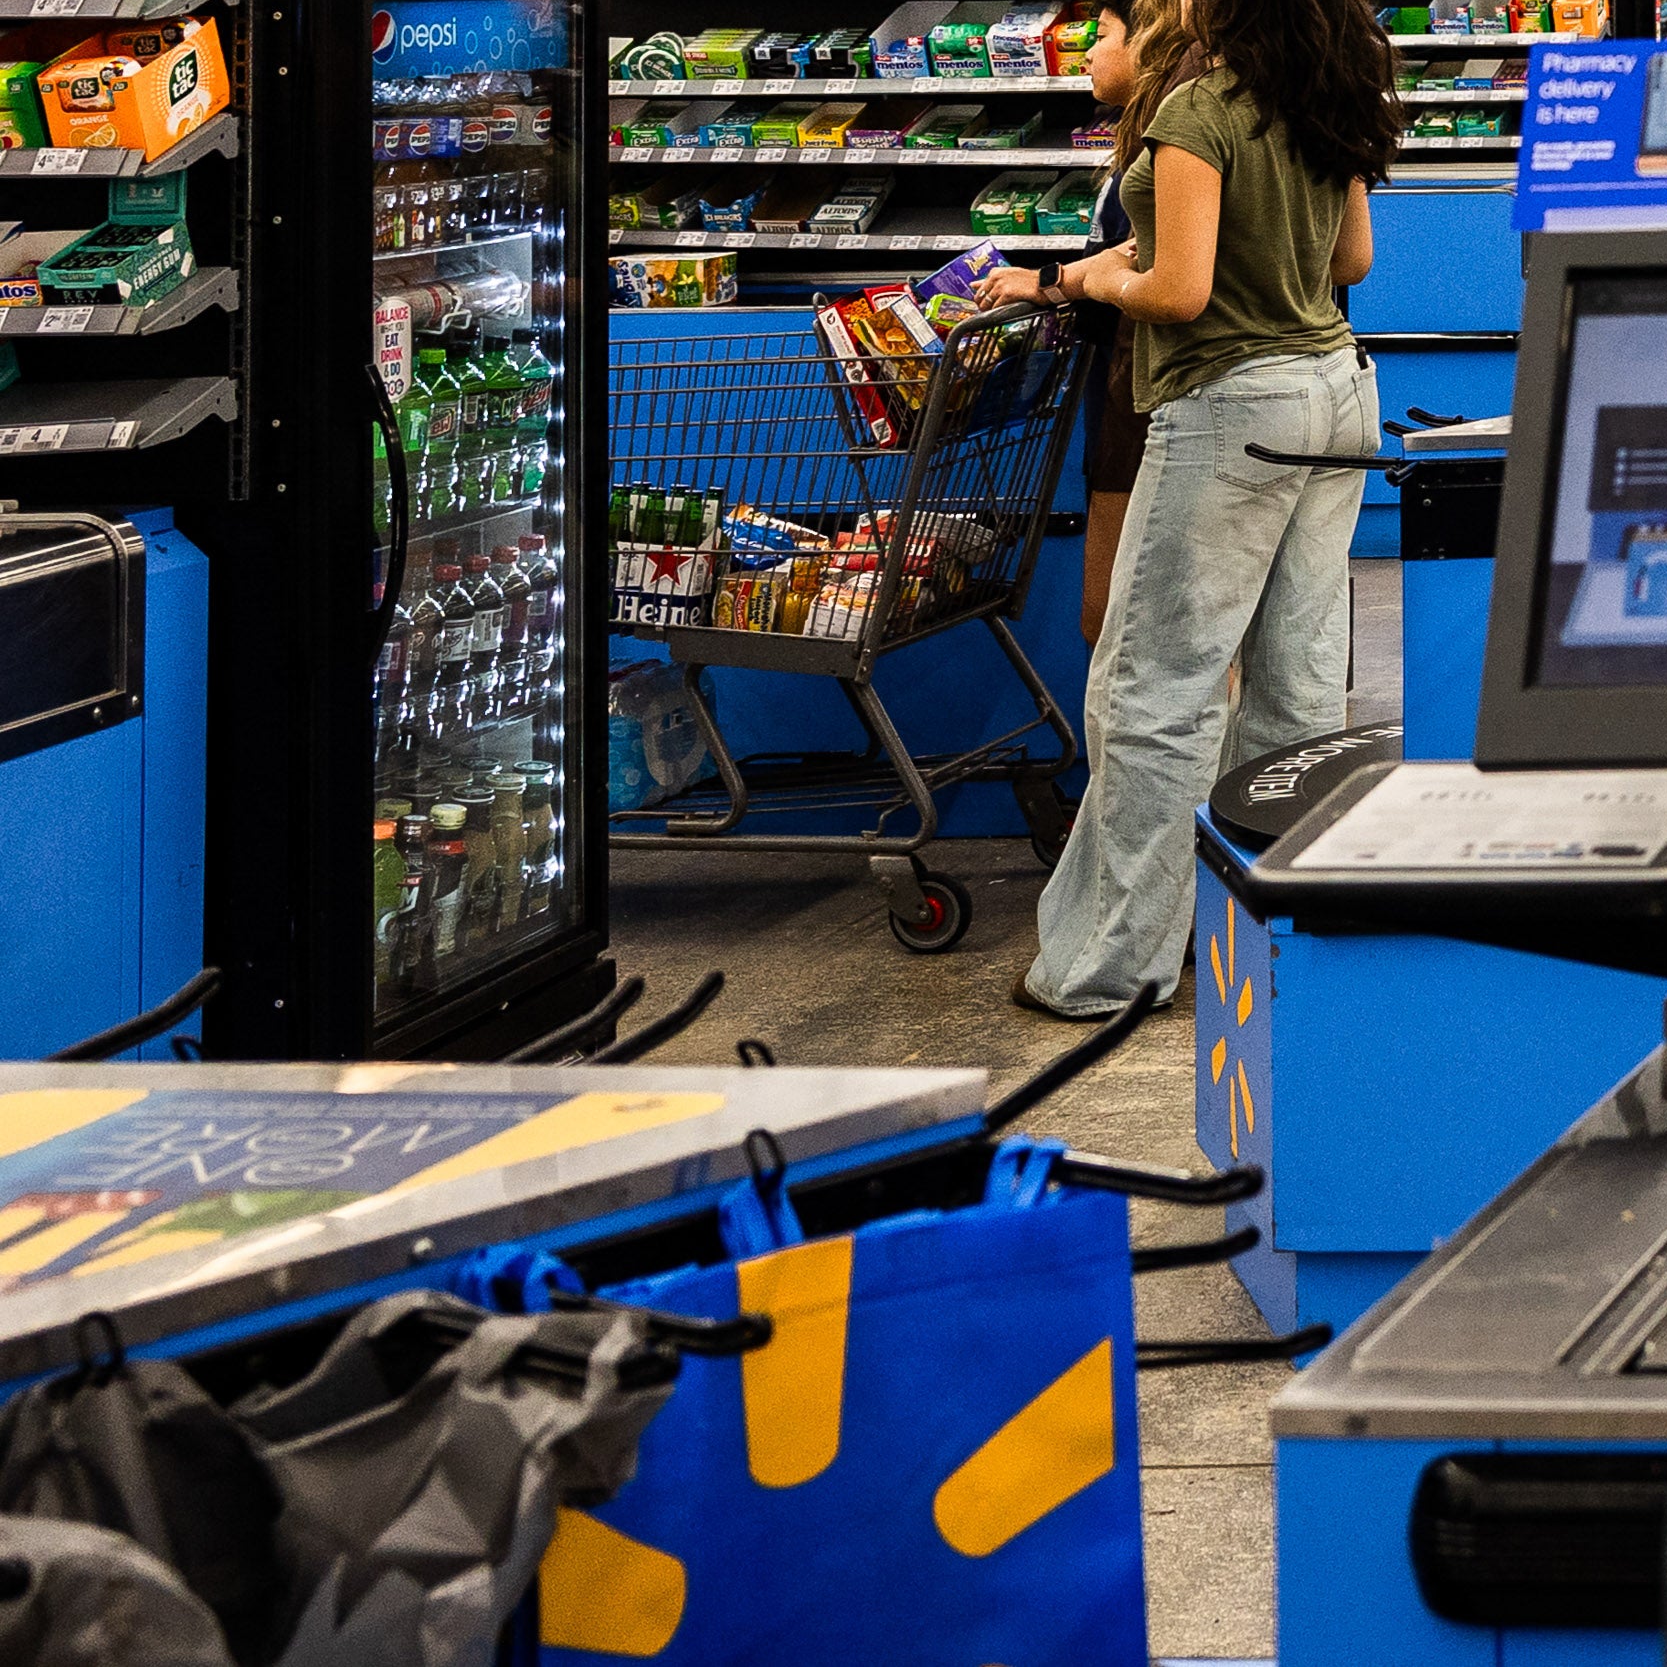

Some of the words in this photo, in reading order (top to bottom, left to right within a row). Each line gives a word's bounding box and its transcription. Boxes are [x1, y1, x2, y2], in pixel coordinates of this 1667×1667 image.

[401, 18, 457, 54] pepsi
[174, 56, 194, 80] tic
[876, 59, 923, 70] mentos
[936, 58, 983, 70] mentos
[993, 58, 1041, 69] mentos
[1542, 52, 1637, 75] Pharmacy
[77, 79, 93, 89] tic
[172, 74, 196, 99] tac
[1539, 79, 1616, 101] delivery
[74, 86, 94, 97] tac
[69, 114, 109, 125] ORANGE
[1536, 104, 1553, 124] is
[1555, 104, 1600, 124] here
[633, 135, 658, 146] Extra
[675, 136, 699, 146] Extra
[719, 136, 743, 146] Extra
[1075, 138, 1115, 147] mento
[820, 206, 861, 215] ALTOIDS
[761, 225, 797, 233] ALTOIDS
[133, 258, 167, 290] ENERGY
[163, 247, 181, 272] GUM
[0, 285, 36, 299] tos
[63, 290, 98, 300] REV
[375, 306, 409, 325] BALANCE
[385, 333, 399, 348] EAT
[380, 347, 403, 363] DRINK
[390, 362, 400, 377] DO
[615, 594, 700, 625] Heine
[1264, 737, 1373, 772] MORE
[80, 1121, 472, 1156] MORE
